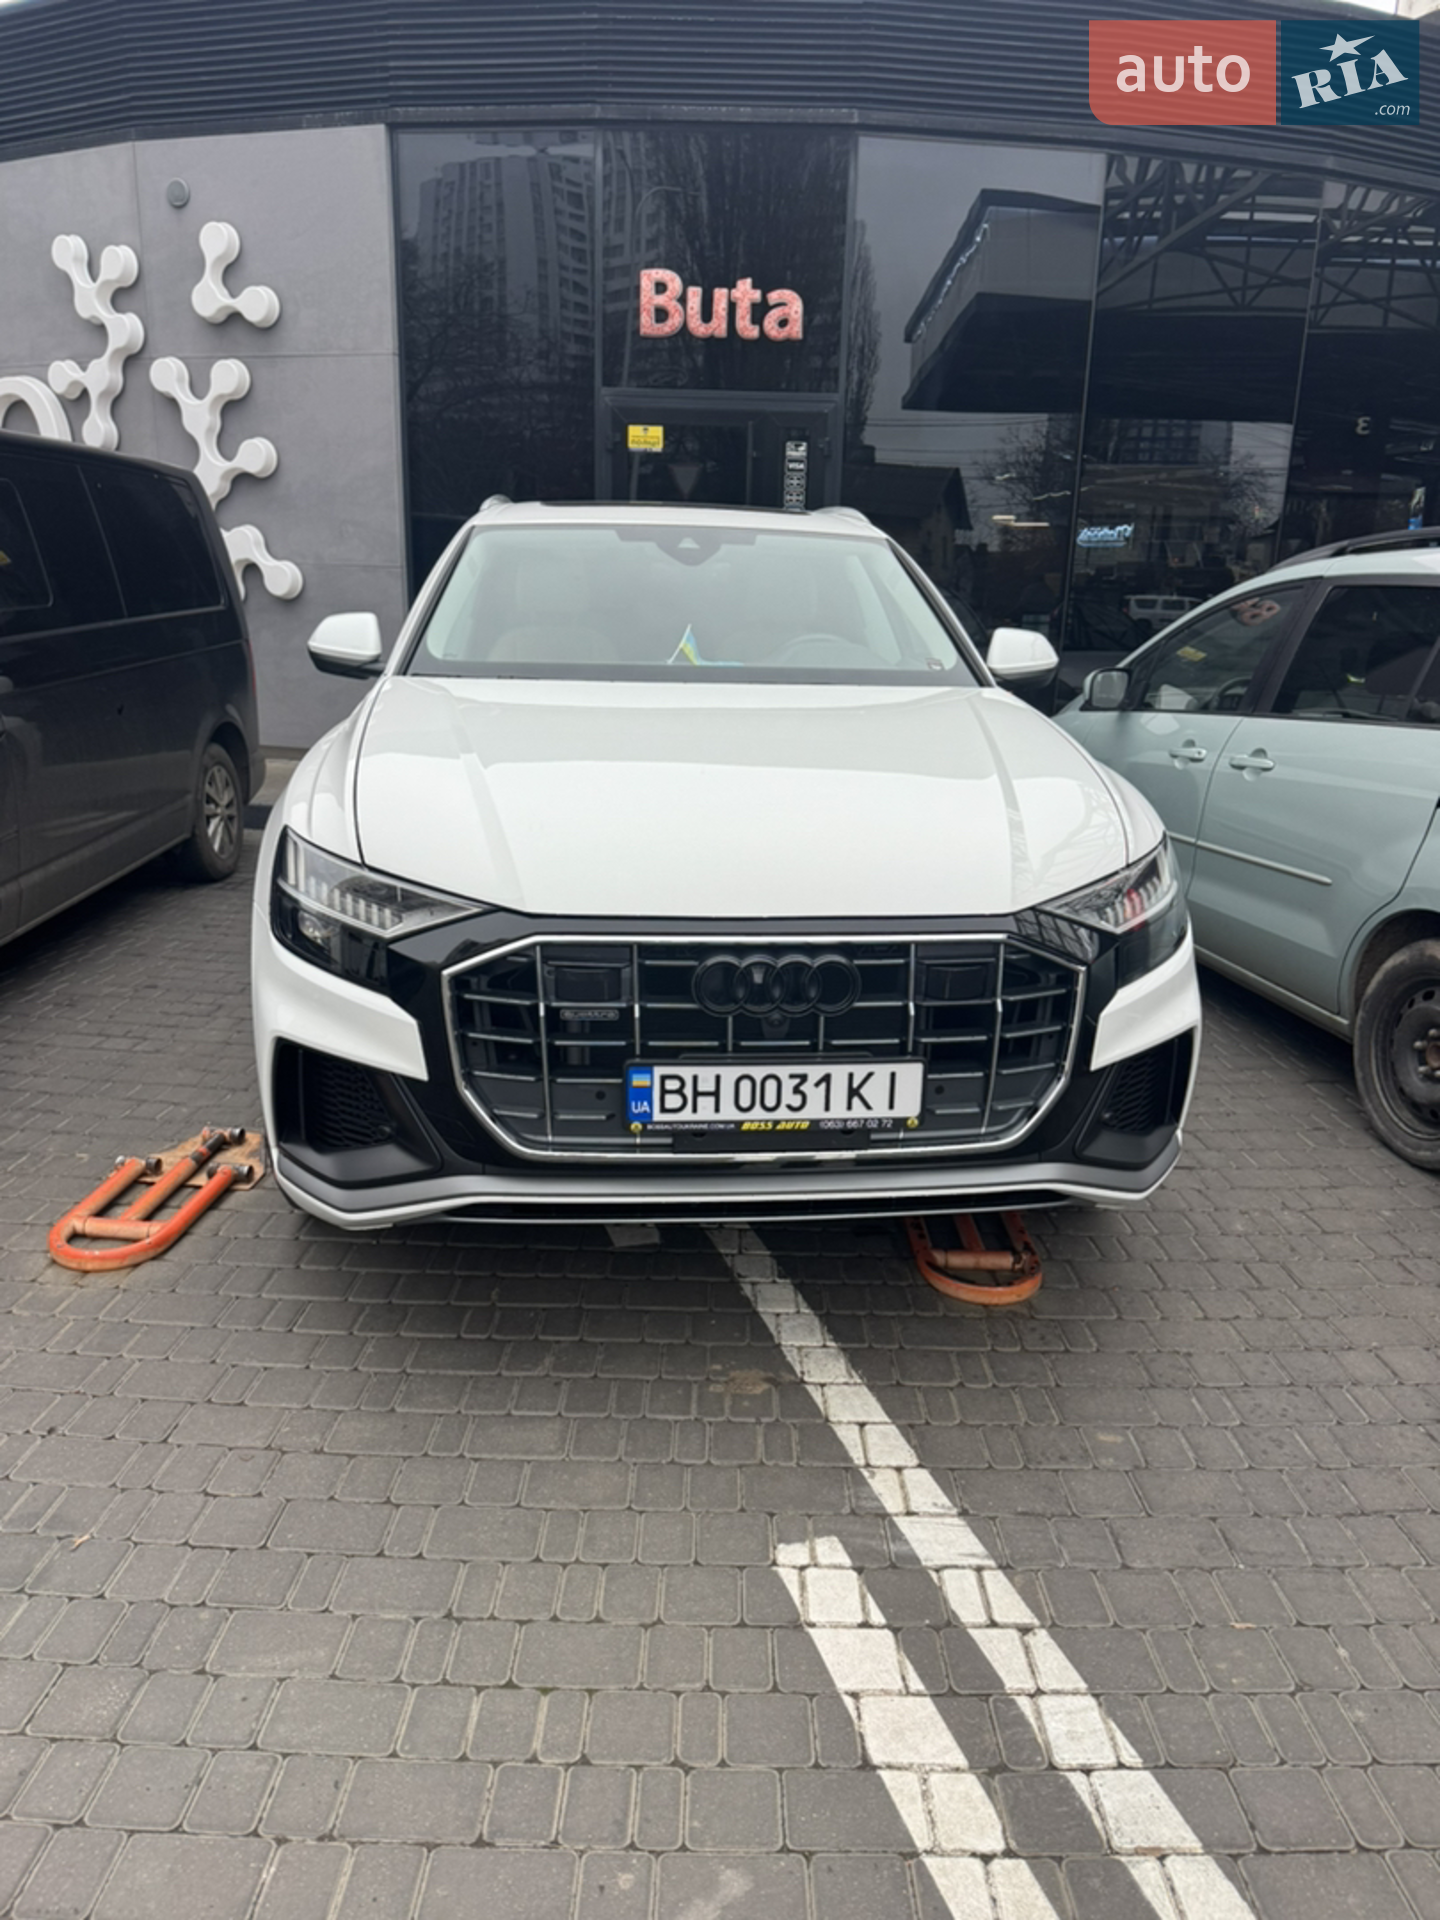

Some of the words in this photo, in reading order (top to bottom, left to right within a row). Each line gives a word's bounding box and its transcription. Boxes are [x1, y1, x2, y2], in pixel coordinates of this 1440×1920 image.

[639, 268, 804, 341] Buta
[658, 1073, 721, 1114] BH
[733, 1072, 832, 1113] 0031
[846, 1071, 897, 1111] KI
[631, 1101, 651, 1114] UA
[740, 1121, 773, 1131] BOSS
[774, 1120, 810, 1130] AUTO
[845, 1119, 865, 1129] 667
[866, 1118, 879, 1129] 02
[881, 1118, 893, 1128] 72
